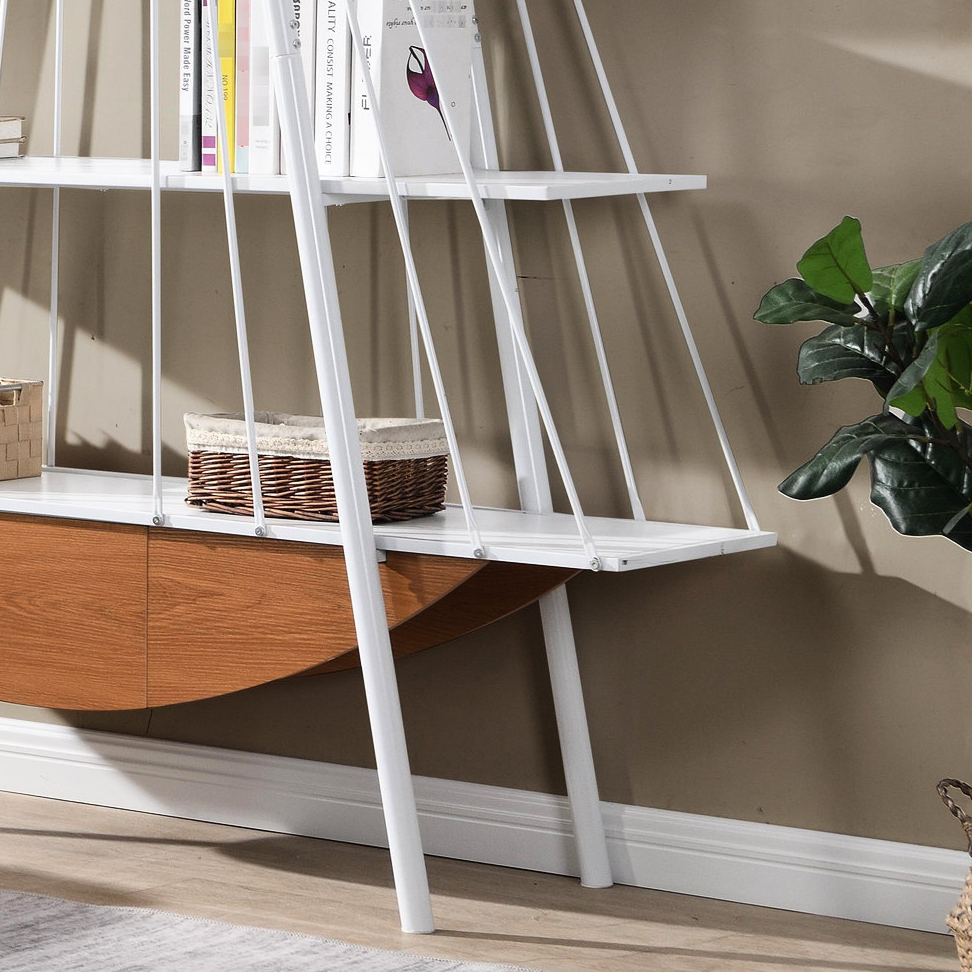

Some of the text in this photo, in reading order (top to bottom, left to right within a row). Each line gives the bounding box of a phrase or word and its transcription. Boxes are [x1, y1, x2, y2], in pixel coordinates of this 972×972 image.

[183, 19, 192, 44] Power
[182, 46, 191, 70] Made
[326, 38, 334, 77] CONSIST
[181, 72, 191, 92] Easy
[325, 81, 333, 120] MAKING
[325, 121, 332, 129] A
[324, 130, 333, 165] CHOICE
